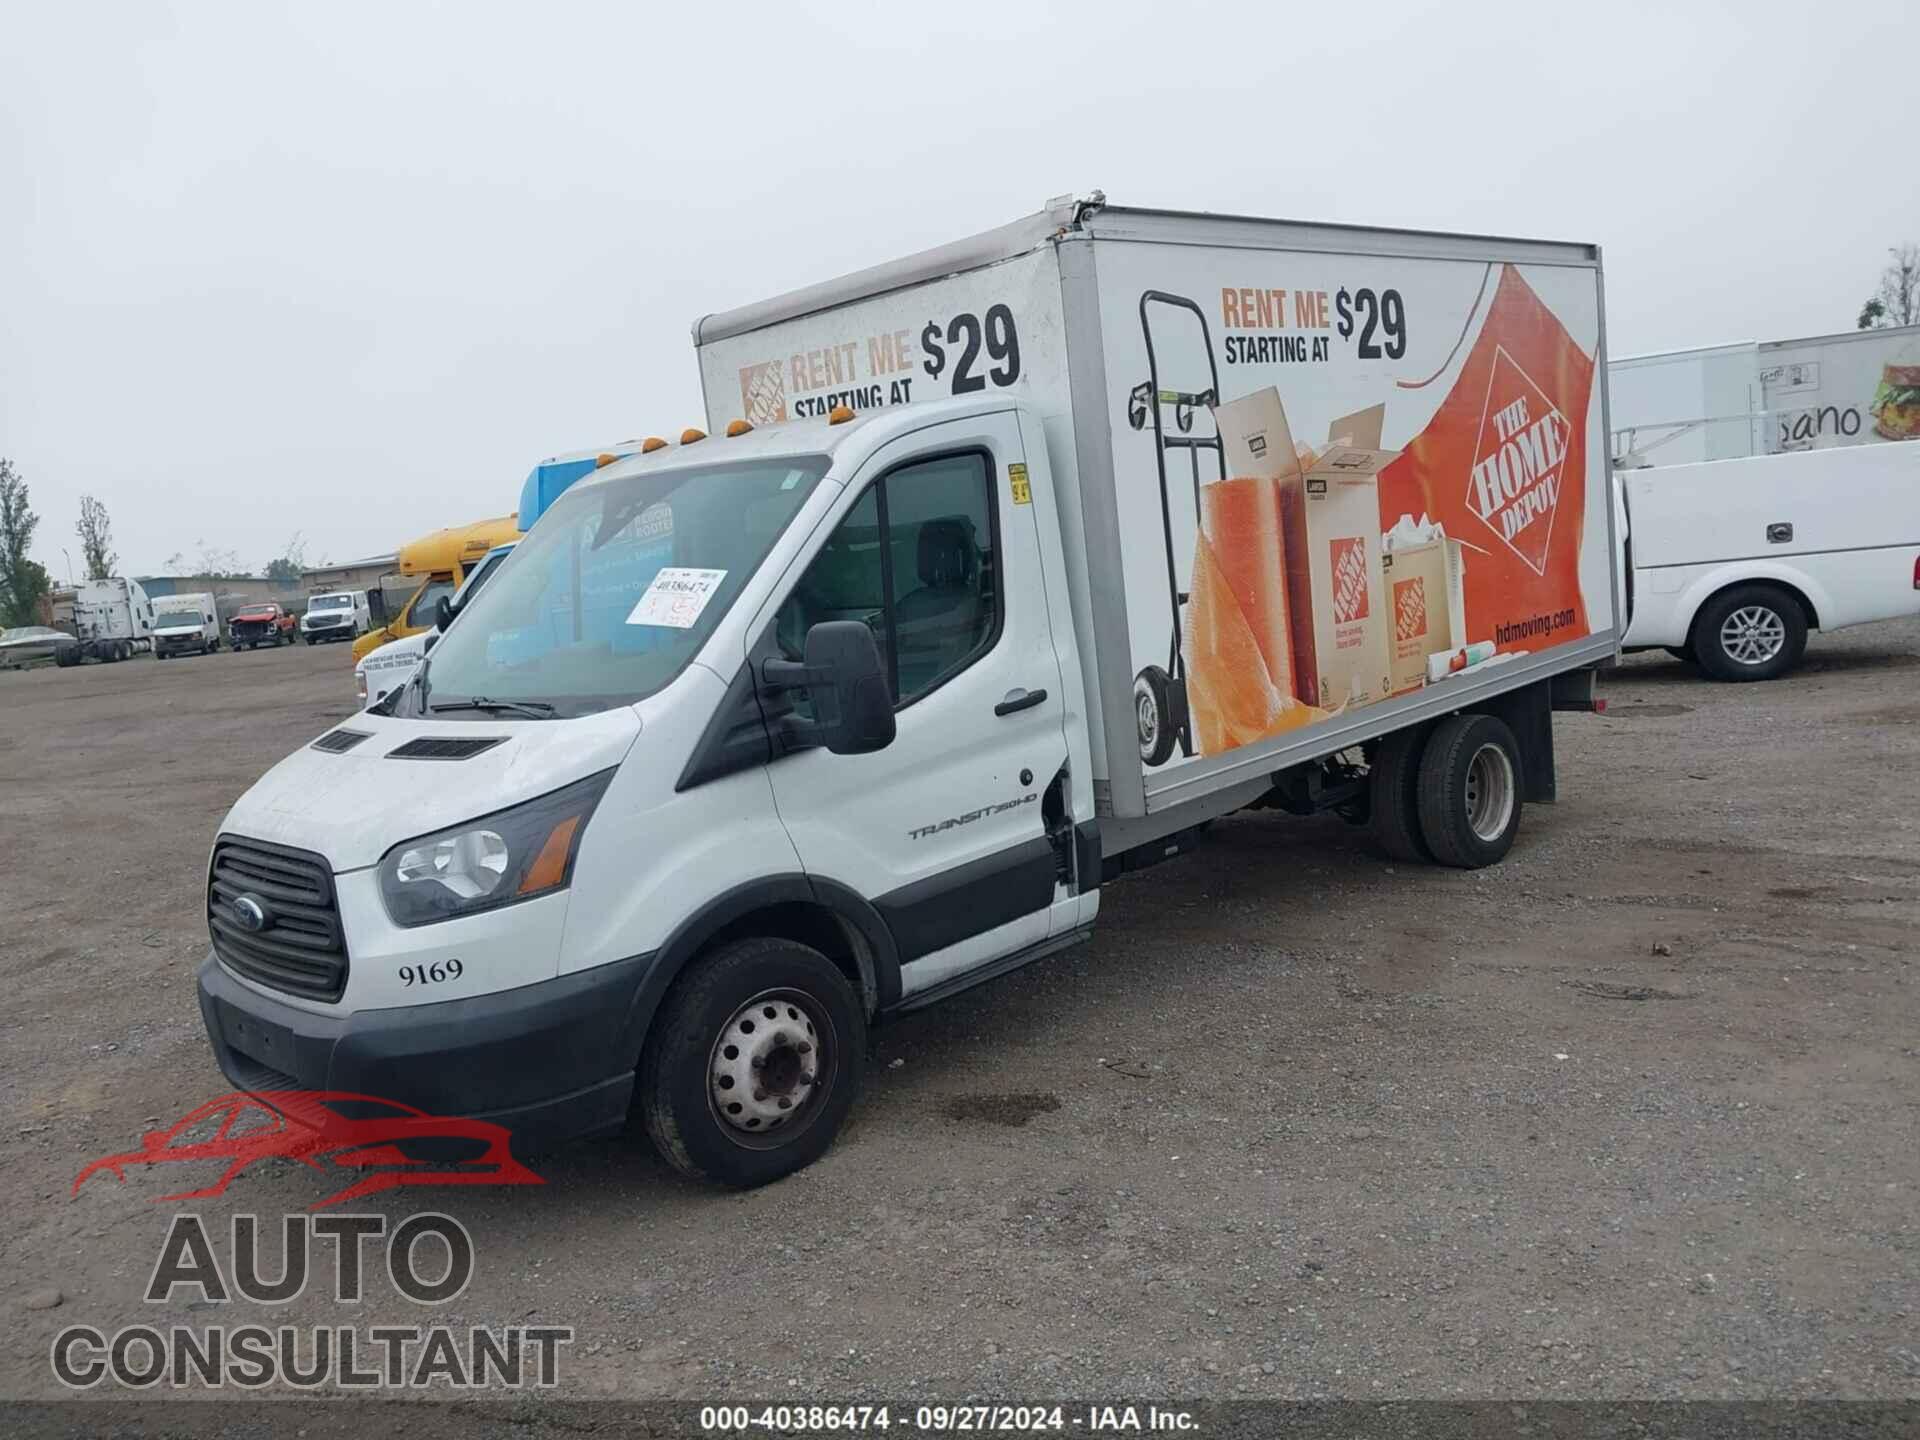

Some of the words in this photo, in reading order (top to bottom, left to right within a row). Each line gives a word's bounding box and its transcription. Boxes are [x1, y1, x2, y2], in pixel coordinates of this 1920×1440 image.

[1221, 287, 1287, 329] RENT
[1295, 290, 1330, 329] ME
[1336, 286, 1407, 360] $29
[791, 342, 858, 394] RENT
[867, 328, 914, 377] ME
[921, 303, 1021, 396] $29
[1225, 336, 1307, 365] STARTING
[1312, 337, 1330, 362] AT
[890, 378, 913, 406] AT
[1493, 396, 1530, 442] THE
[1472, 409, 1566, 521] HOME
[1500, 474, 1558, 542] DEPOT
[1495, 608, 1576, 645] hdmoving.com
[399, 958, 463, 987] 9169
